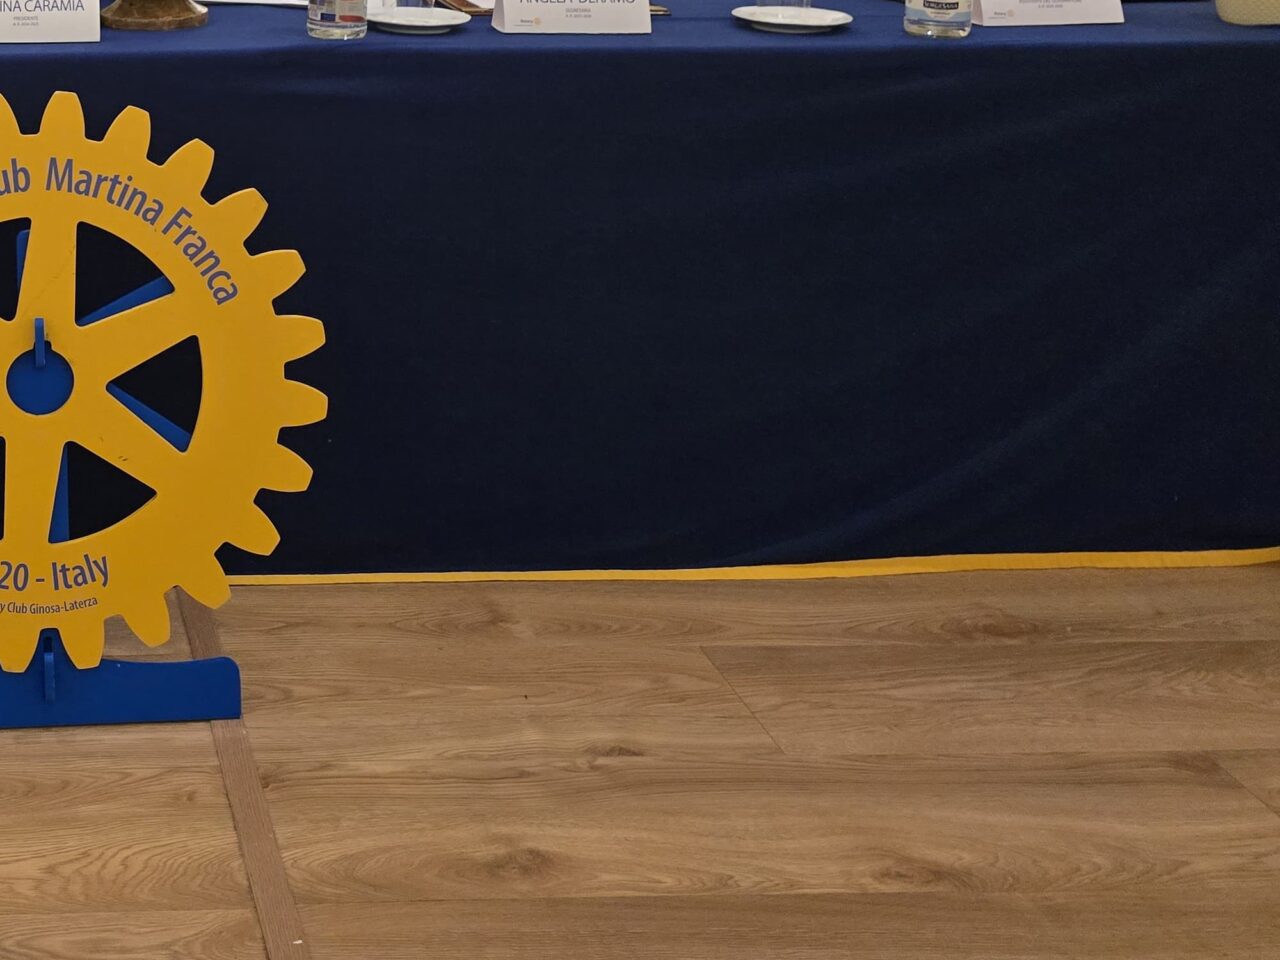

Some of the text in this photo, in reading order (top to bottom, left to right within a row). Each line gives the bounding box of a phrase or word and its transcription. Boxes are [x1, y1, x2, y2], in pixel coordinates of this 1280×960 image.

[24, 0, 85, 12] CARAMIA
[45, 156, 163, 226] Martina
[160, 205, 239, 306] Franca
[51, 553, 109, 591] Italy
[7, 601, 27, 614] Club
[29, 596, 98, 615] Ginosa-Laterza
